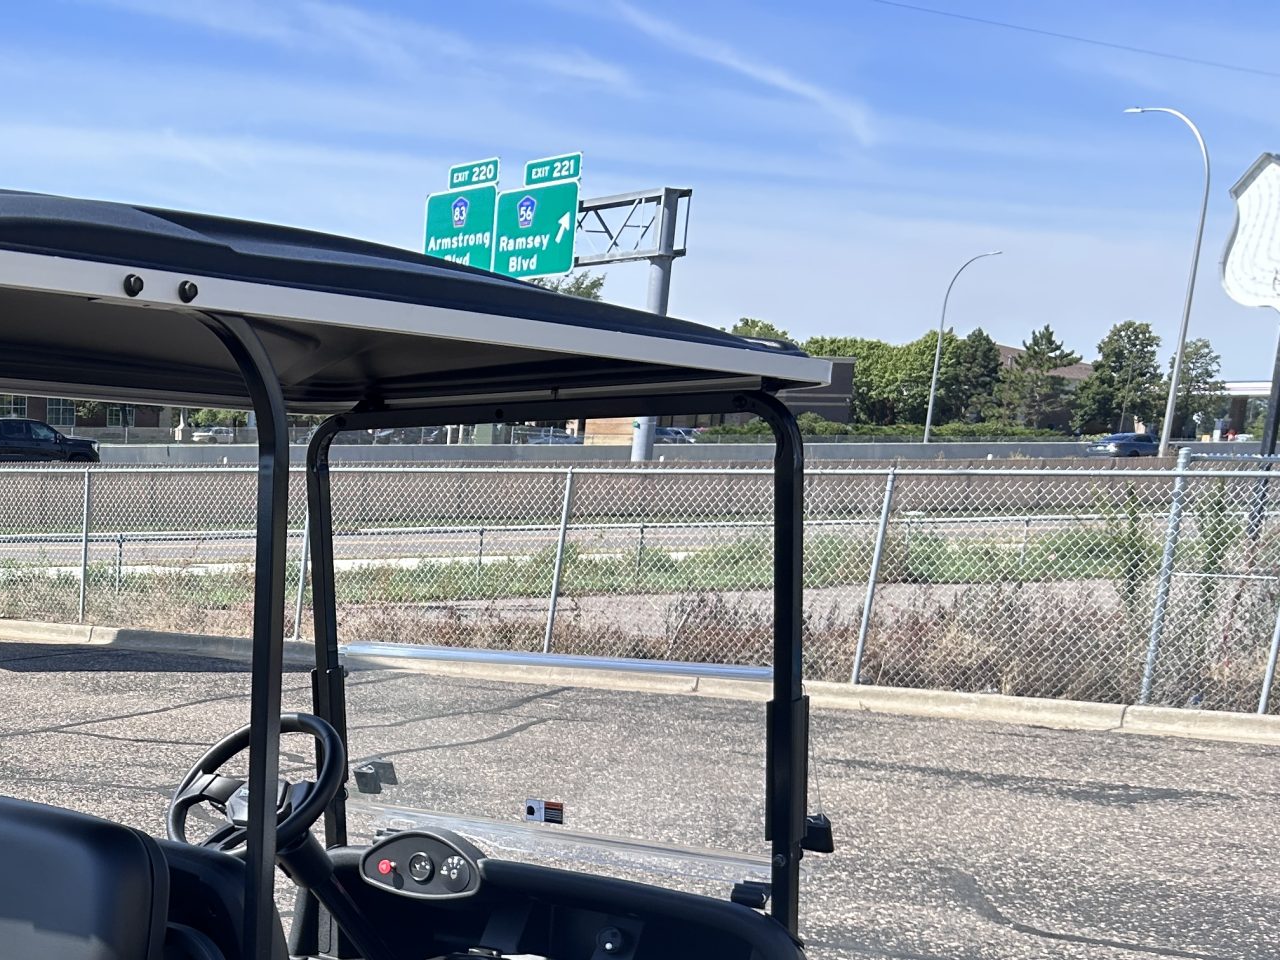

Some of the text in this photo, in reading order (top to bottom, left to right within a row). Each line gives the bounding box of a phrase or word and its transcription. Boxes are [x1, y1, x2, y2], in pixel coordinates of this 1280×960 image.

[453, 164, 495, 184] EXIT 220
[531, 159, 575, 180] EXIT 221
[454, 206, 466, 221] 83
[520, 206, 532, 221] 56
[427, 232, 491, 252] Armstrong
[499, 233, 550, 252] Ramsey
[508, 253, 538, 273] Blvd
